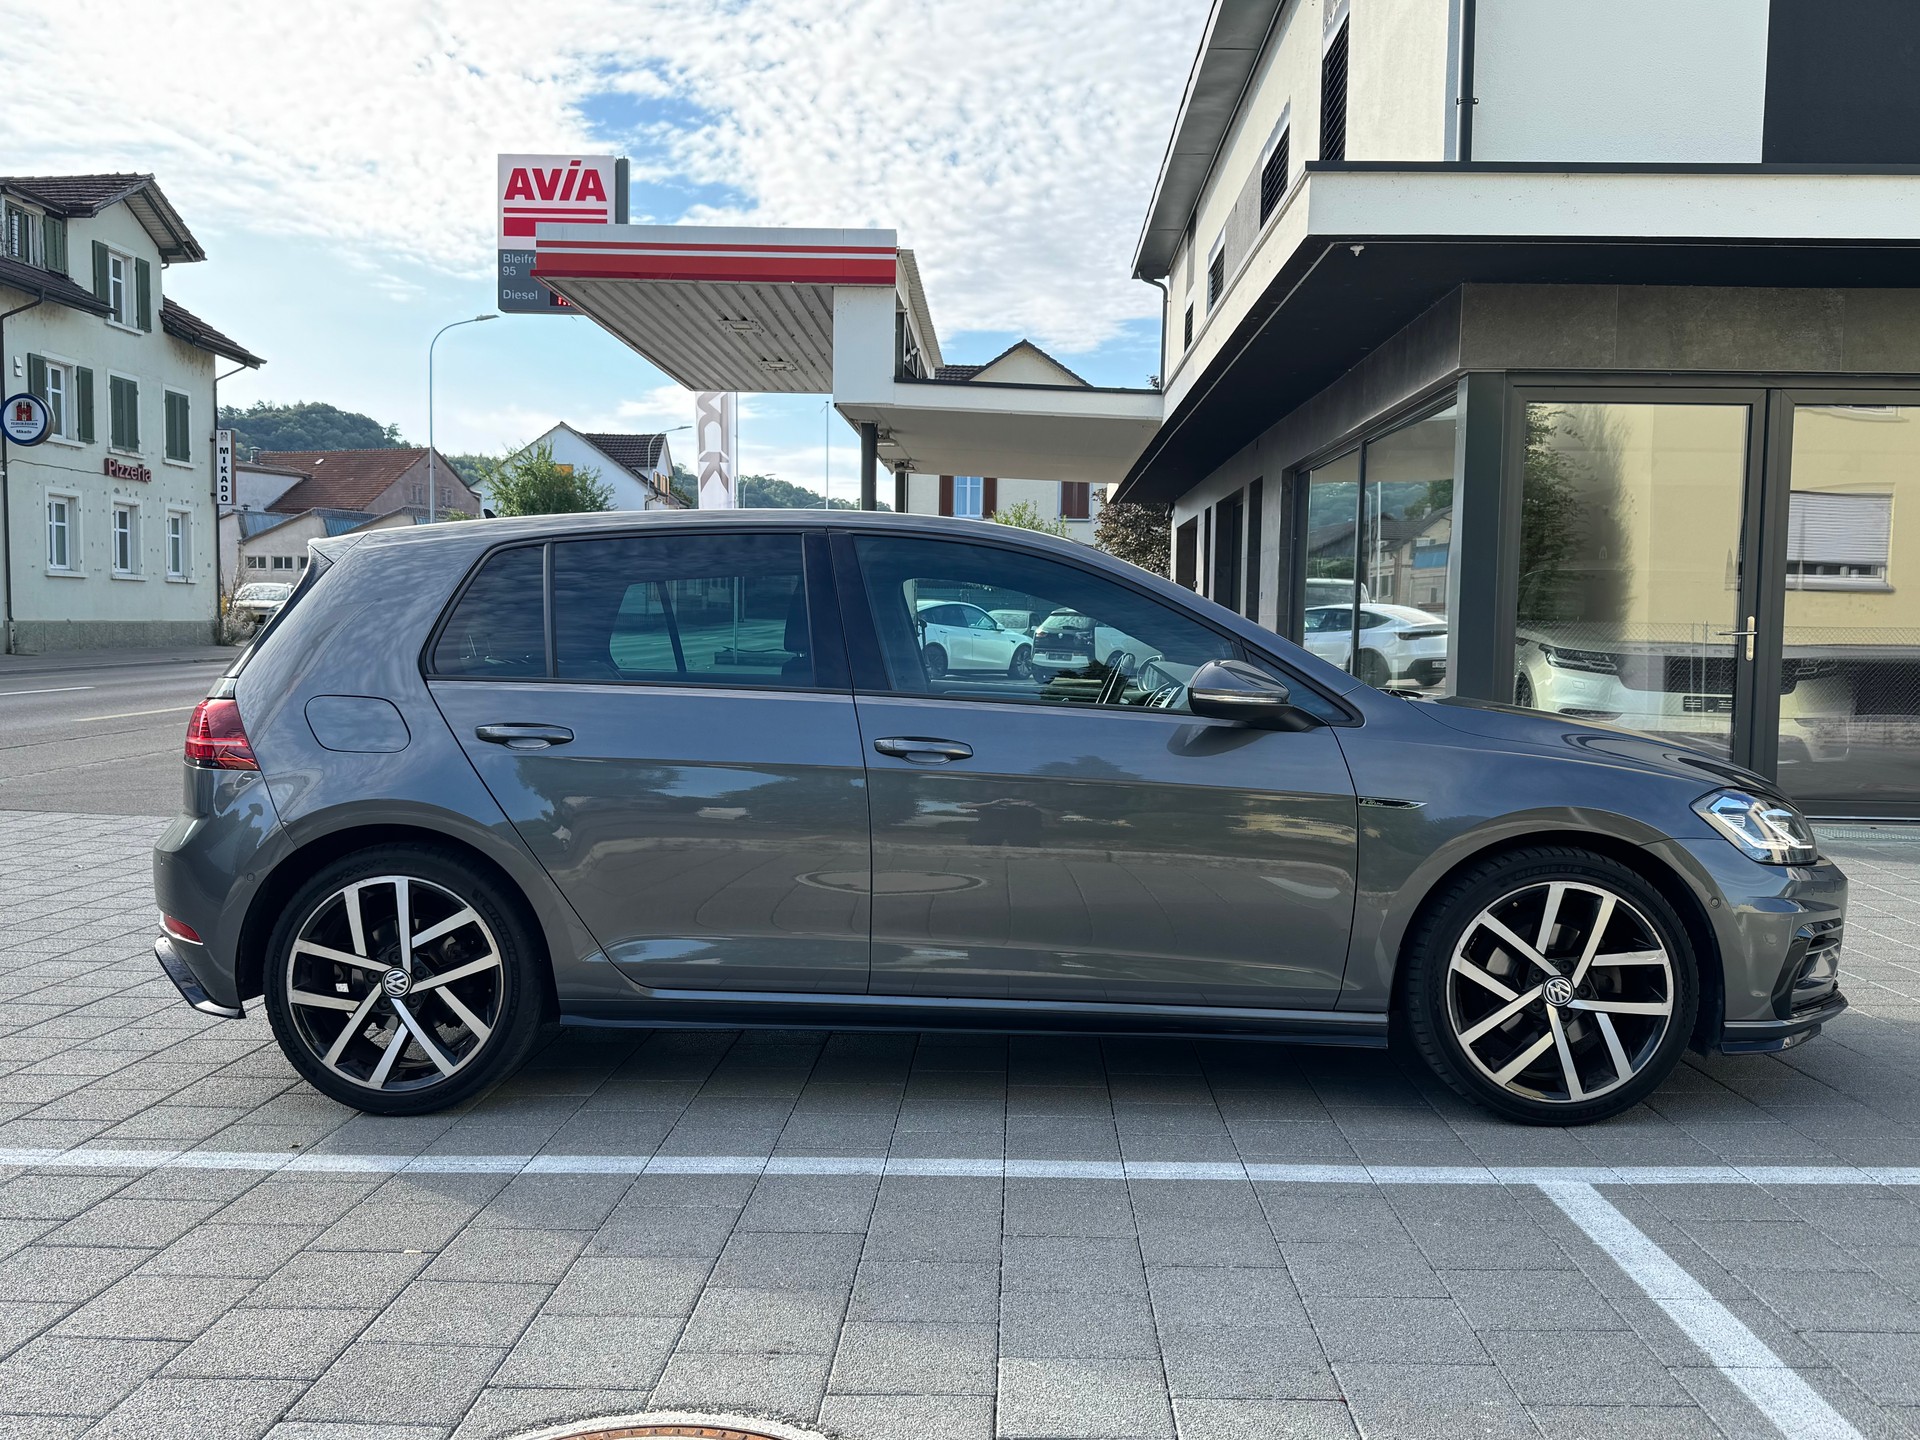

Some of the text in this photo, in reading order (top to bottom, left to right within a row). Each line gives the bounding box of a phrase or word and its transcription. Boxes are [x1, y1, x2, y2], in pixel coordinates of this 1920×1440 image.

[502, 266, 516, 276] 95
[503, 290, 538, 300] Diesel
[107, 457, 152, 482] Pizzeria
[219, 447, 229, 502] MIKADO
